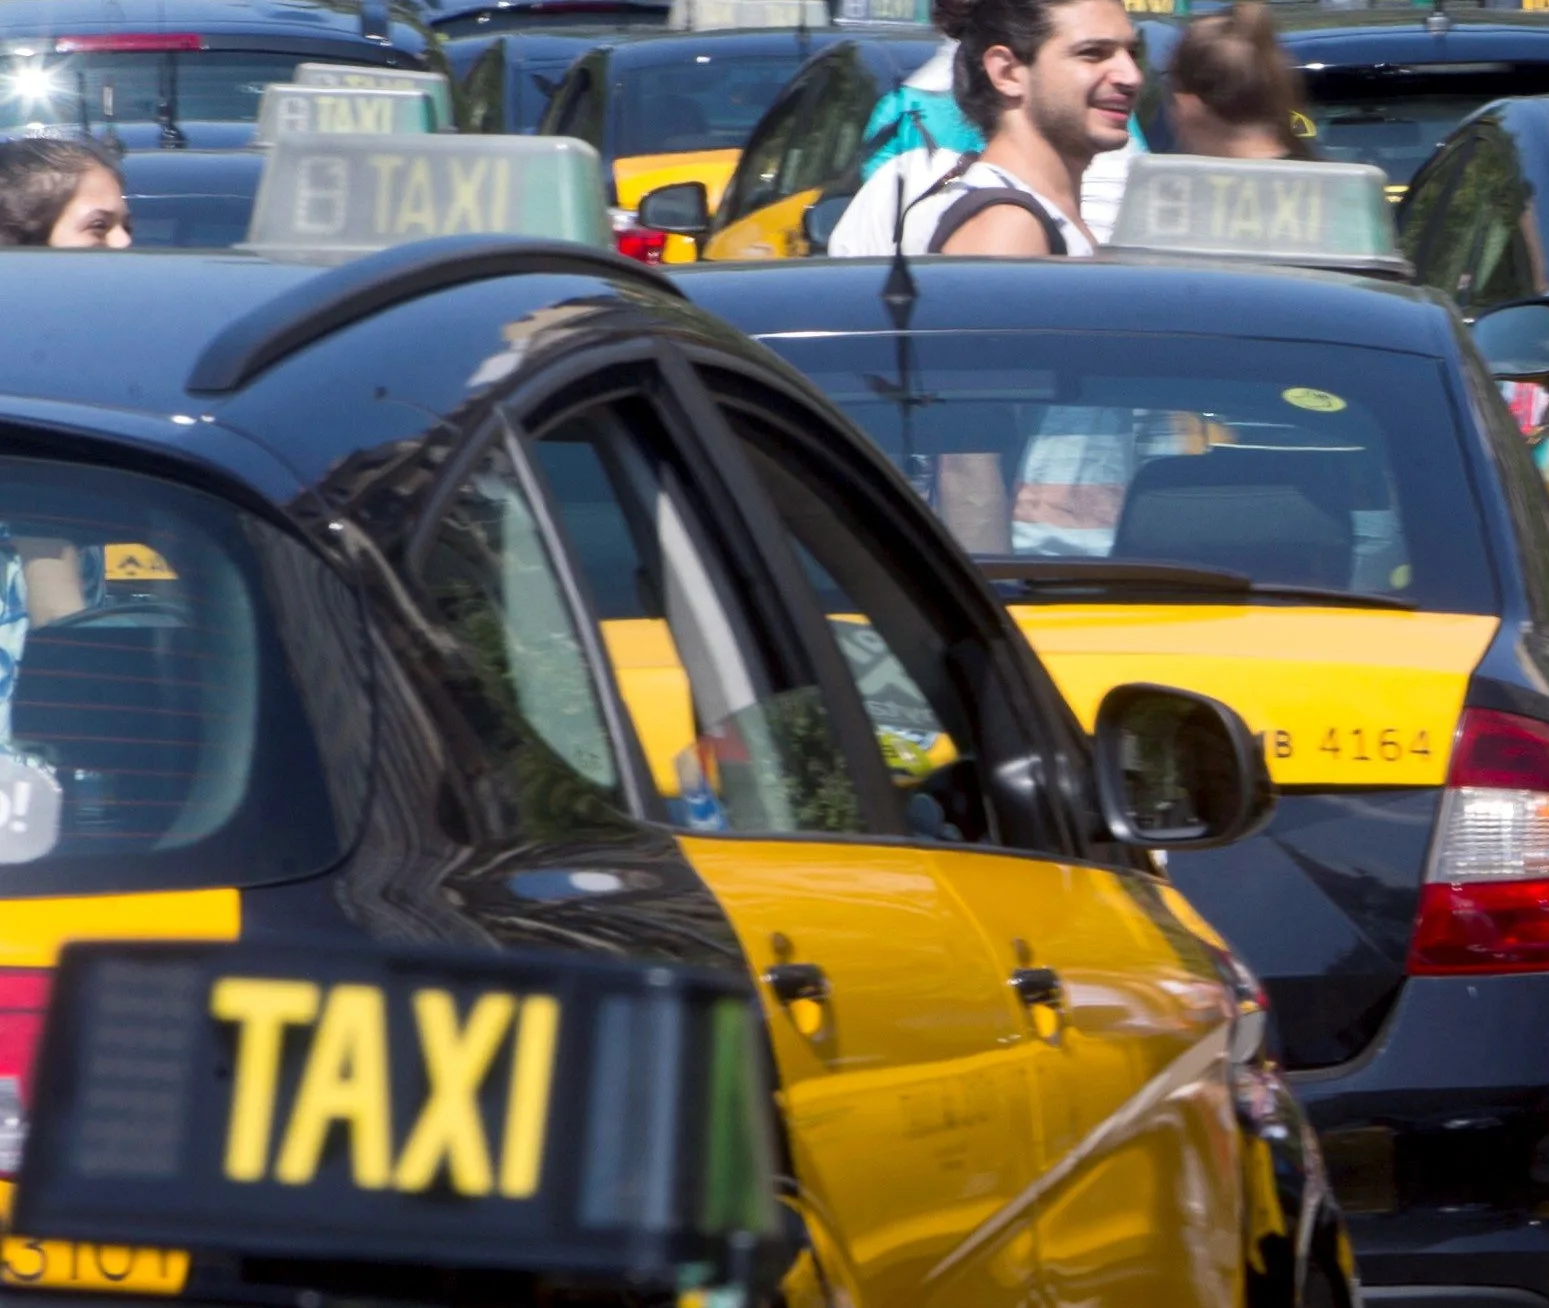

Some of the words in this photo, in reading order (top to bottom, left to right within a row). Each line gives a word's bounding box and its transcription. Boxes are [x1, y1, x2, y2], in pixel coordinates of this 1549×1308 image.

[314, 96, 394, 134] TAXI
[367, 154, 511, 235] TAXI
[1205, 174, 1323, 241] TAXI
[1318, 727, 1431, 762] 4164
[210, 976, 562, 1200] TAXI
